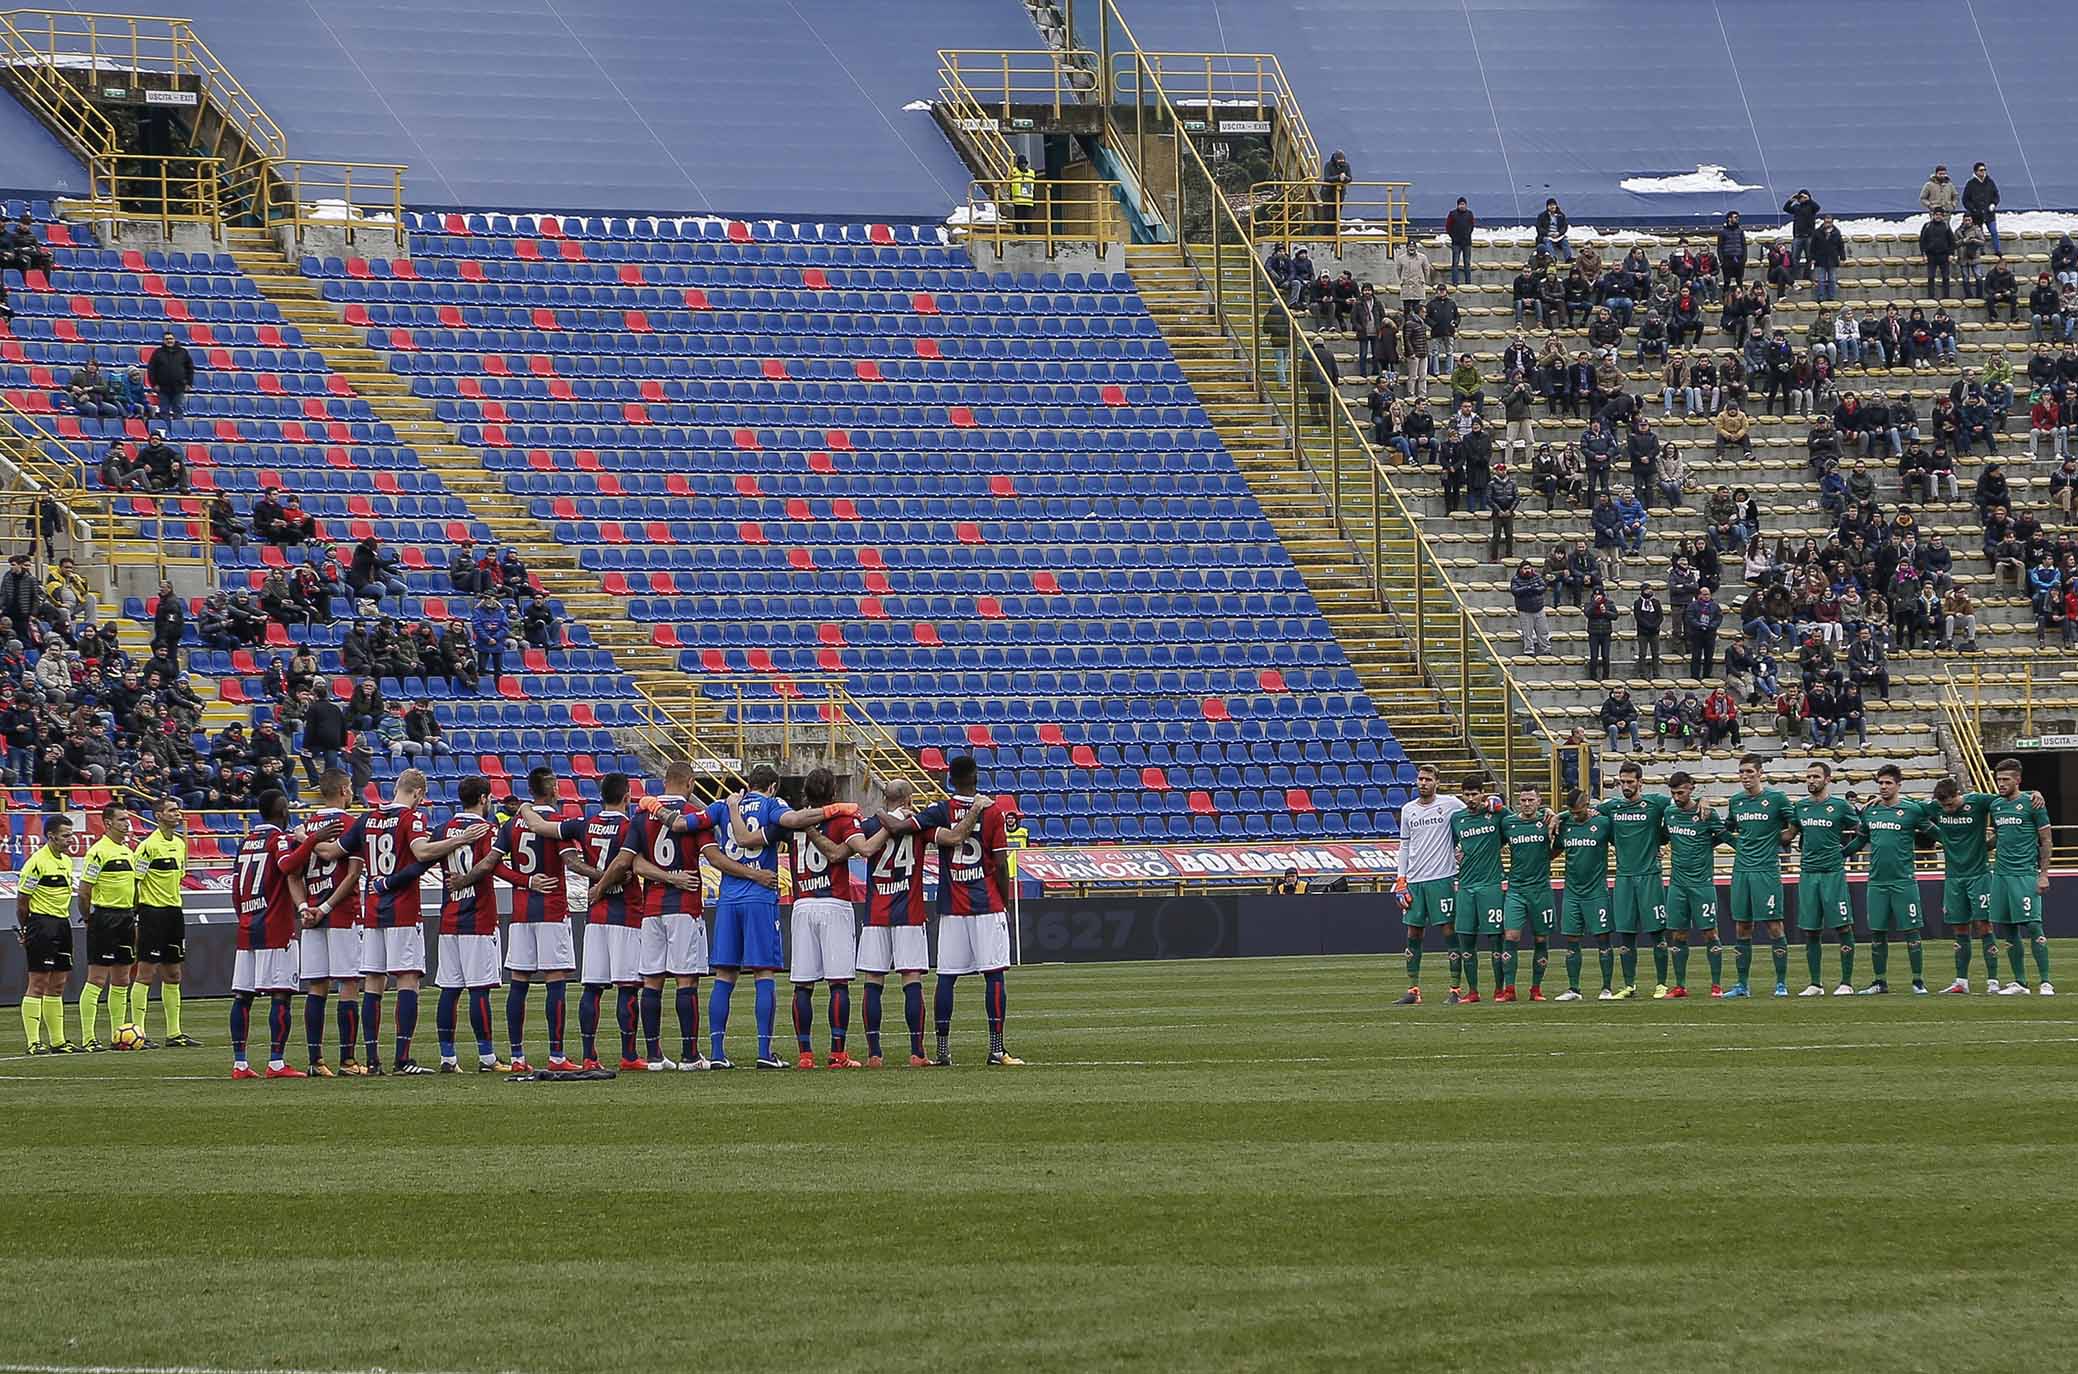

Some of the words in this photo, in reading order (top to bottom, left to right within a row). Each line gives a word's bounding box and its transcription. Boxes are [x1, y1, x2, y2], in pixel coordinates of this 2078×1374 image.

[1221, 123, 1245, 131] USCITA
[2043, 736, 2072, 745] USCITA
[1409, 816, 1444, 830] folletto
[1613, 812, 1647, 823] folletto
[1459, 824, 1496, 839] folletto
[517, 831, 537, 874] 5
[653, 823, 676, 867] 6
[793, 831, 829, 874] 16
[365, 832, 397, 877] 18
[591, 837, 612, 872] 7
[871, 834, 916, 878] 24
[1023, 852, 1098, 862] BOLOGNA
[1104, 851, 1144, 861] CLUB
[1171, 849, 1348, 872] BOLOGNA
[237, 852, 269, 896] 77
[1026, 860, 1172, 880] PIANORO
[1439, 897, 1454, 914] 57
[1767, 894, 1776, 909] 4
[1838, 900, 1848, 917] 5
[2023, 896, 2032, 911] 3
[1487, 908, 1504, 924] 28
[1541, 908, 1554, 924] 17
[1599, 907, 1608, 923] 2
[1652, 904, 1667, 921] 13
[1701, 902, 1717, 918] 24
[1908, 902, 1917, 918] 9
